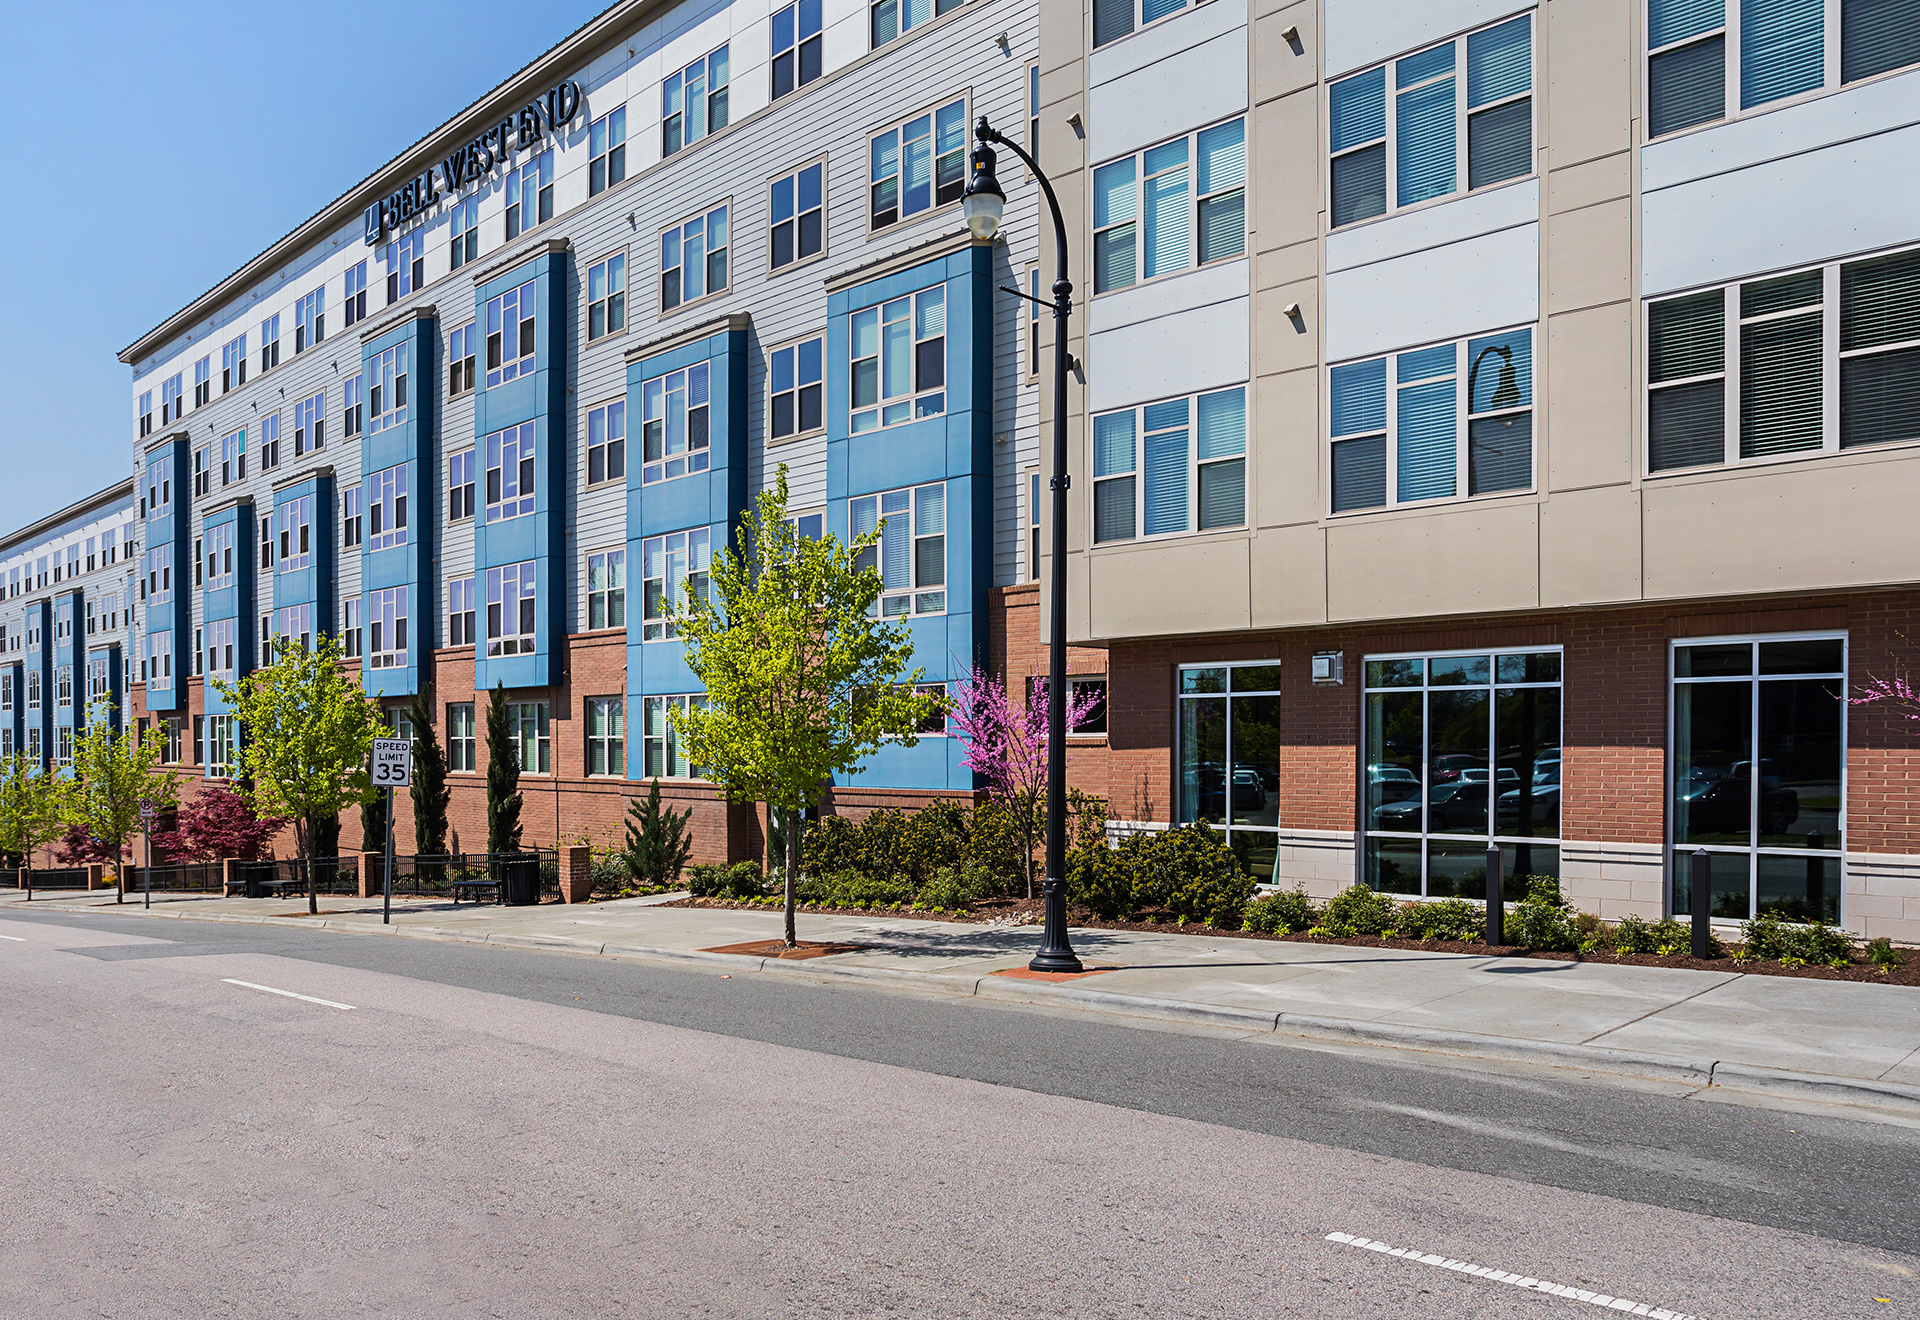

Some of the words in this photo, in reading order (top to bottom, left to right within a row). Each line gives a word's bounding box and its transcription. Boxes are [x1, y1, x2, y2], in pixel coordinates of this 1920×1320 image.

[387, 170, 440, 231] BELL
[441, 117, 513, 193] WEST
[515, 81, 580, 152] END
[376, 742, 408, 751] SPEED
[379, 753, 404, 761] LIMIT
[376, 763, 405, 781] 35
